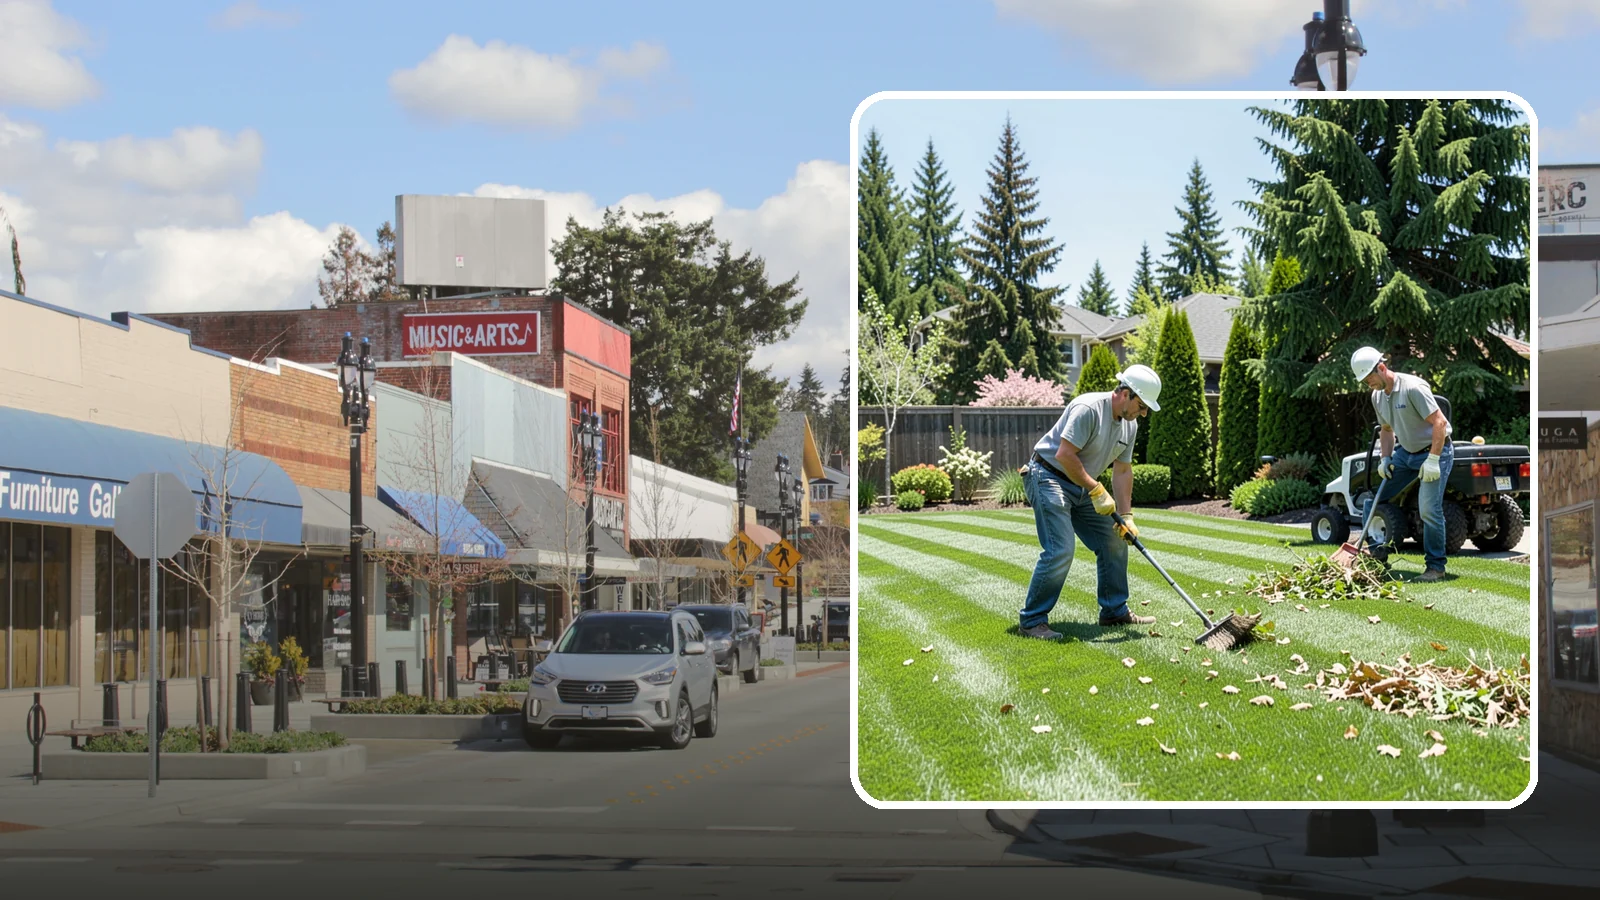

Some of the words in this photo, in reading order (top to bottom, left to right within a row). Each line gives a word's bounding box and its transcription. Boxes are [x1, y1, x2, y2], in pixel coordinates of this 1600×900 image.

[408, 323, 520, 349] MUSIC&ARTS
[0, 471, 79, 515] Furniture
[89, 482, 121, 519] Gal
